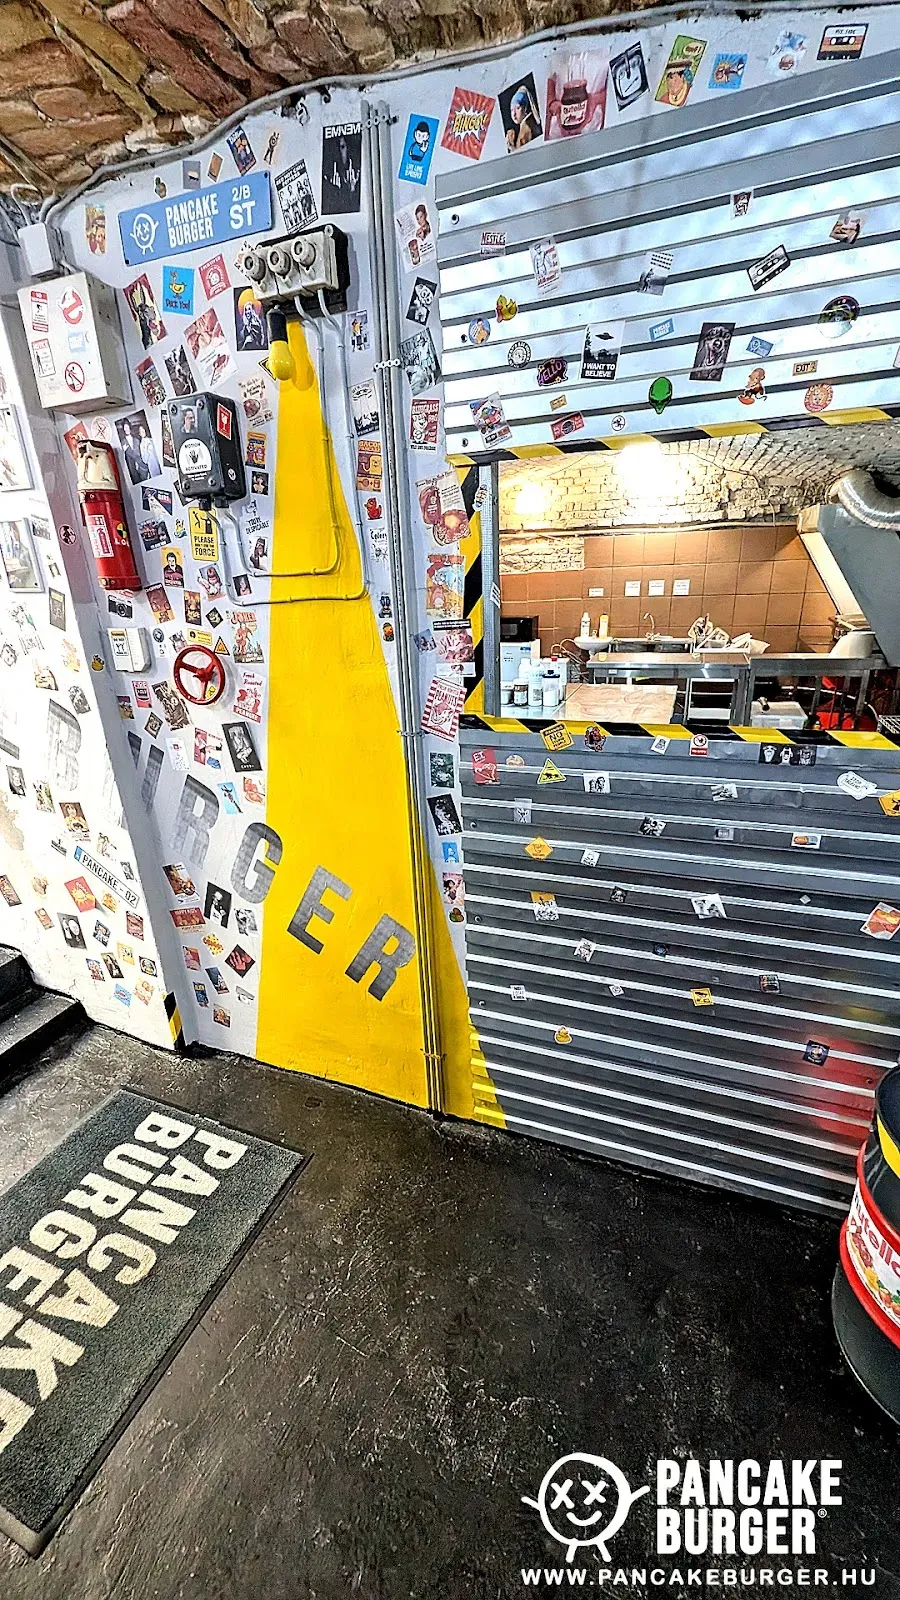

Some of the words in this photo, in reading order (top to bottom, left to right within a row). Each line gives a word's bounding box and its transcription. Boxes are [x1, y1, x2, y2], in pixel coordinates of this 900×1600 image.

[453, 112, 488, 133] BINGO!
[231, 184, 251, 202] 2/B
[165, 193, 220, 227] PANCAKE
[230, 201, 256, 230] ST
[168, 217, 214, 248] BURGER
[539, 361, 564, 383] HELLO
[585, 370, 612, 378] BELIEVE
[795, 361, 809, 373] EXIT
[186, 464, 208, 472] ACTIVATED
[194, 535, 214, 543] PLEASE
[195, 547, 215, 557] FORCE
[435, 690, 458, 707] PEANUTS
[550, 731, 563, 740] NO
[82, 853, 119, 889] PANCAKE
[125, 891, 137, 904] 02
